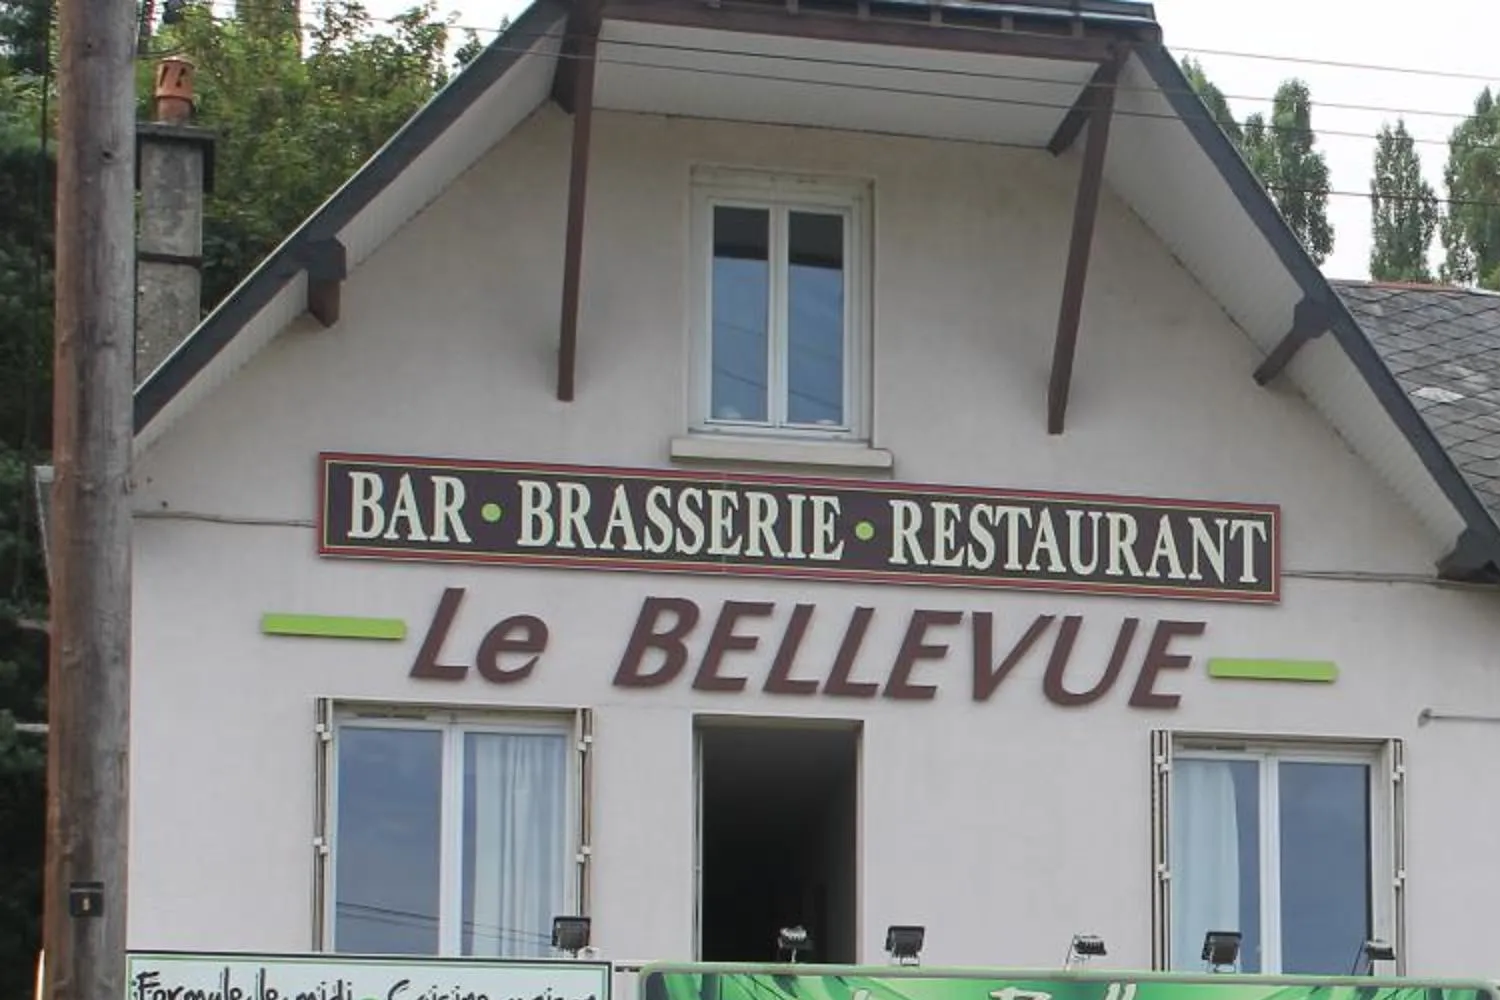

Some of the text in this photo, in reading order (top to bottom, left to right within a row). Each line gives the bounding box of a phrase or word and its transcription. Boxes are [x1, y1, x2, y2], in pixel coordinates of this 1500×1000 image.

[347, 471, 1269, 586] BAR BRASSERIE RESTAURANT
[408, 586, 1206, 710] Le BELLEVUE
